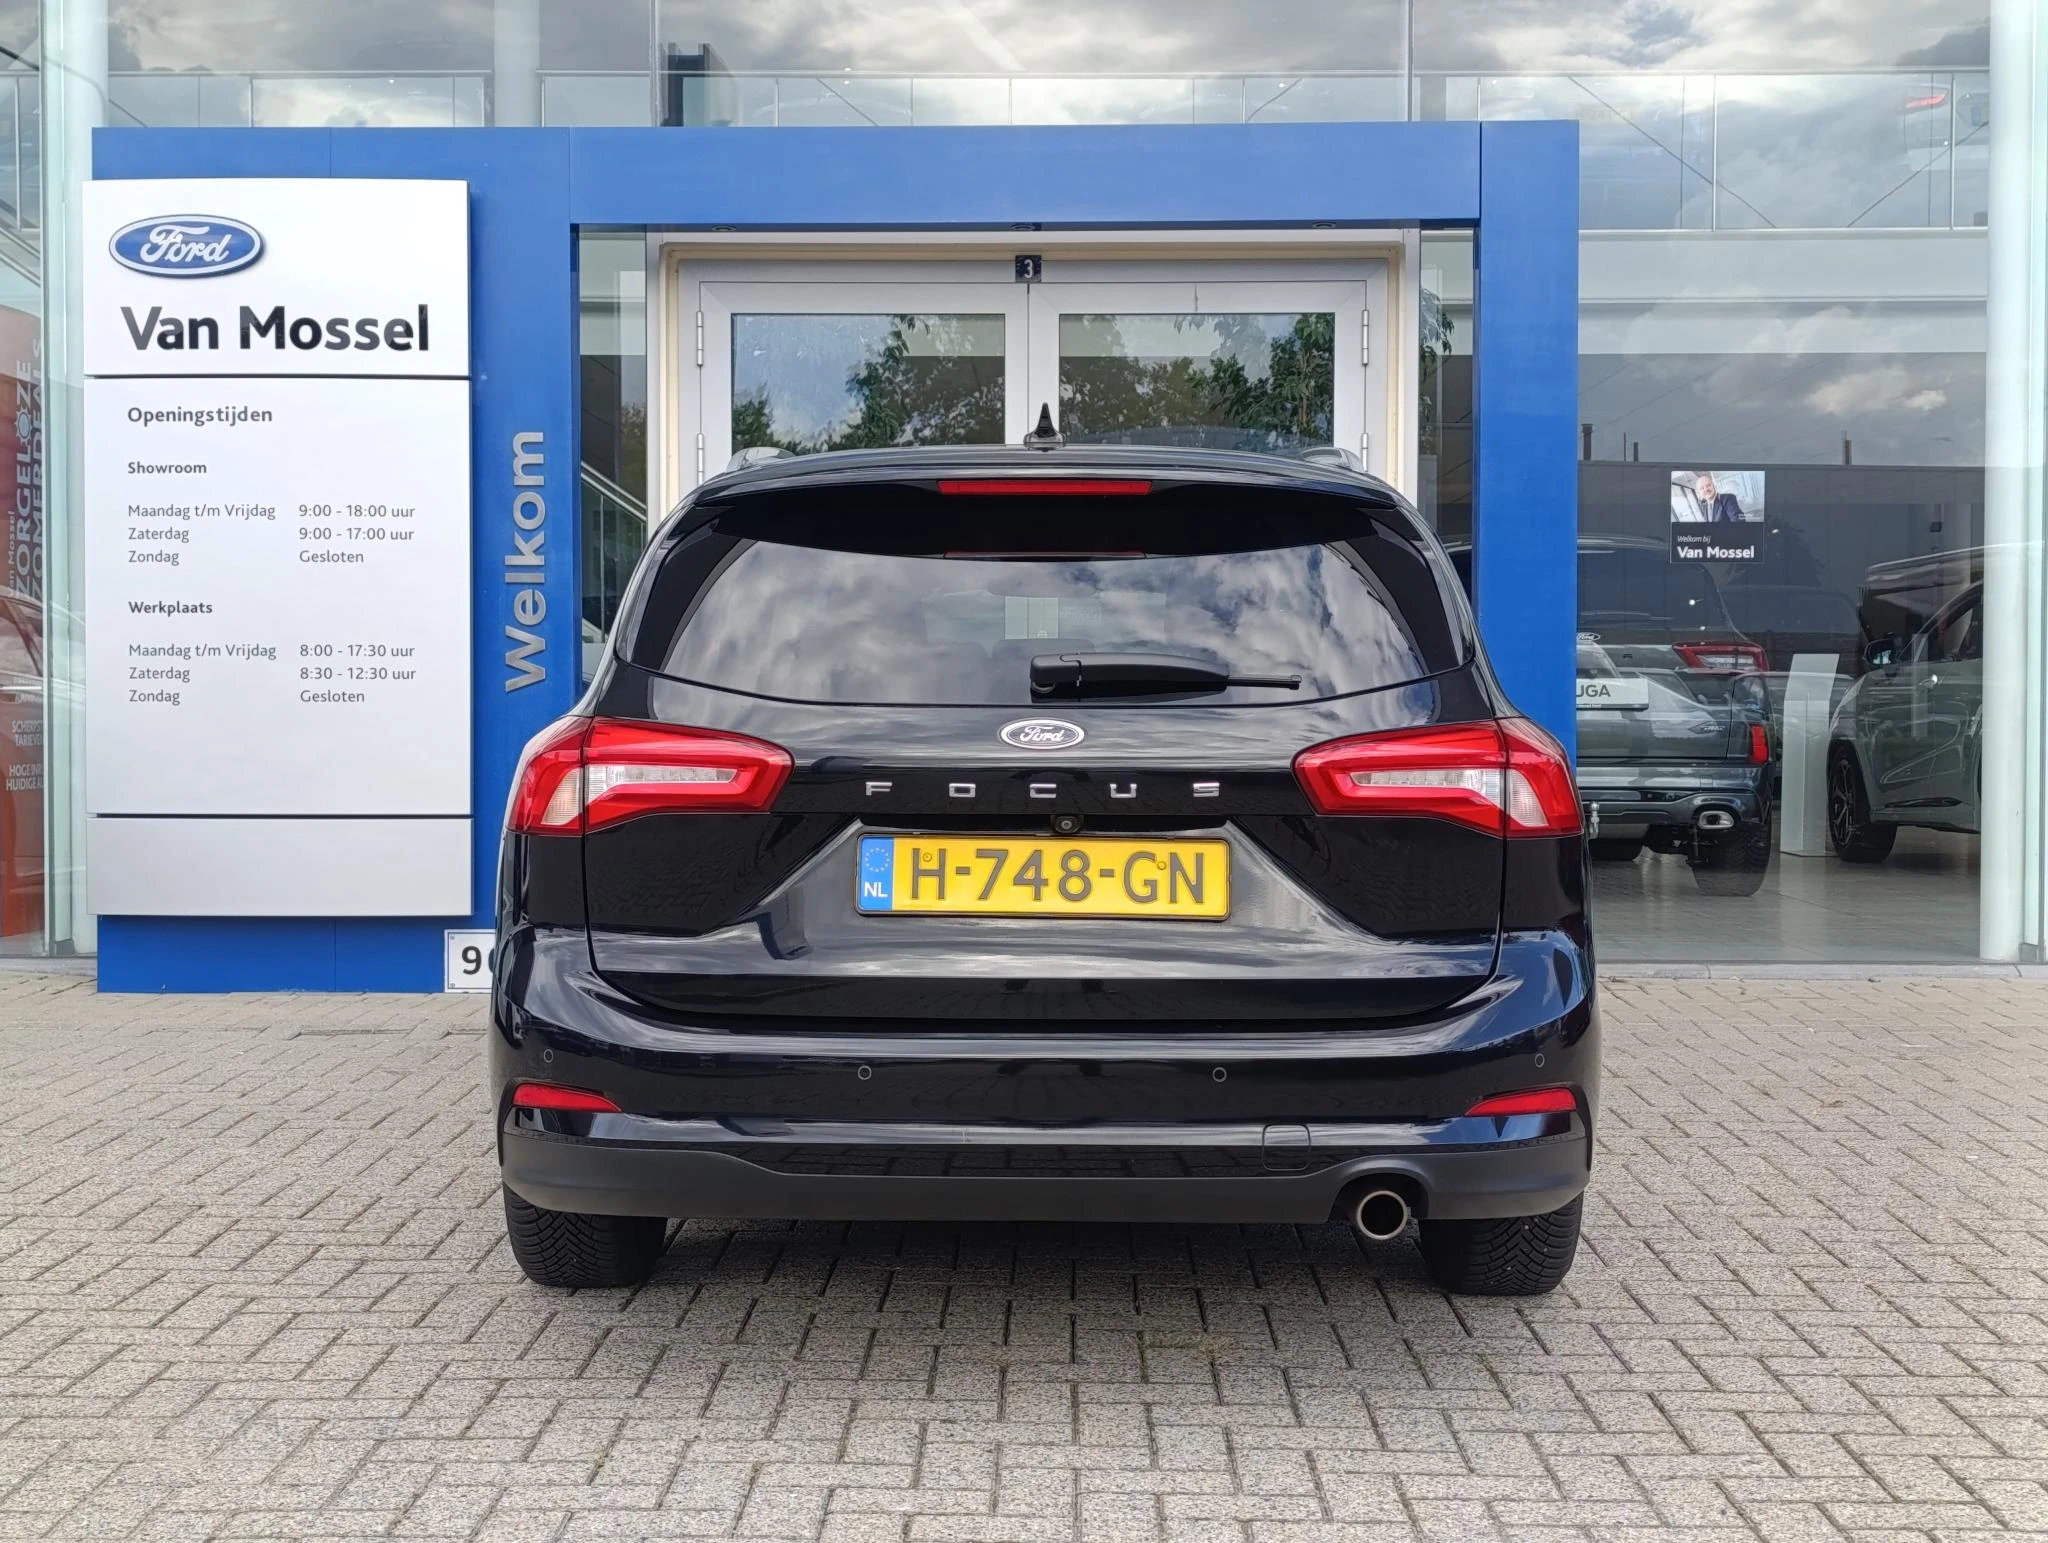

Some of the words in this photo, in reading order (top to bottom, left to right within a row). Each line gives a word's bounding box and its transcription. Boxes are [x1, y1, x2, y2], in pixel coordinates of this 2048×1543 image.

[140, 225, 232, 262] Ford
[1023, 258, 1034, 279] 3
[121, 306, 219, 351] Van
[240, 304, 430, 352] Mossel
[127, 406, 273, 427] Openingstijden
[127, 460, 207, 475] Showroom
[128, 503, 191, 521] Maandag
[194, 503, 221, 519] t/m
[224, 503, 276, 521] Vrijdag
[298, 504, 332, 518] 9:00
[345, 504, 387, 518] 18:00
[391, 507, 416, 518] uur
[8, 510, 16, 566] Mossel
[127, 526, 190, 544] Zaterdag
[298, 526, 332, 540] 9:00
[346, 527, 386, 541] 17:00
[390, 530, 415, 541] uur
[1677, 535, 1702, 543] Welkom
[1703, 535, 1711, 544] bij
[128, 549, 180, 567] Zondag
[299, 549, 365, 563] Gesloten
[1676, 546, 1703, 558] Van
[1706, 545, 1755, 558] Mossel
[504, 431, 547, 693] Welkom
[127, 600, 213, 618] Werkplaats
[128, 643, 192, 661] Maandag
[195, 643, 221, 658] t/m
[225, 643, 277, 661] Vrijdag
[299, 644, 333, 657] 8:00
[347, 644, 387, 657] 17:30
[390, 647, 416, 657] uur
[129, 666, 191, 684] Zaterdag
[299, 667, 333, 680] 8:30
[347, 667, 388, 680] 12:30
[392, 670, 417, 680] uur
[128, 688, 181, 707] Zondag
[299, 689, 365, 703] Gesloten
[1020, 725, 1065, 741] Ford
[865, 781, 1220, 798] FOCUS
[864, 883, 888, 898] NL
[910, 847, 1205, 905] H-748-GN
